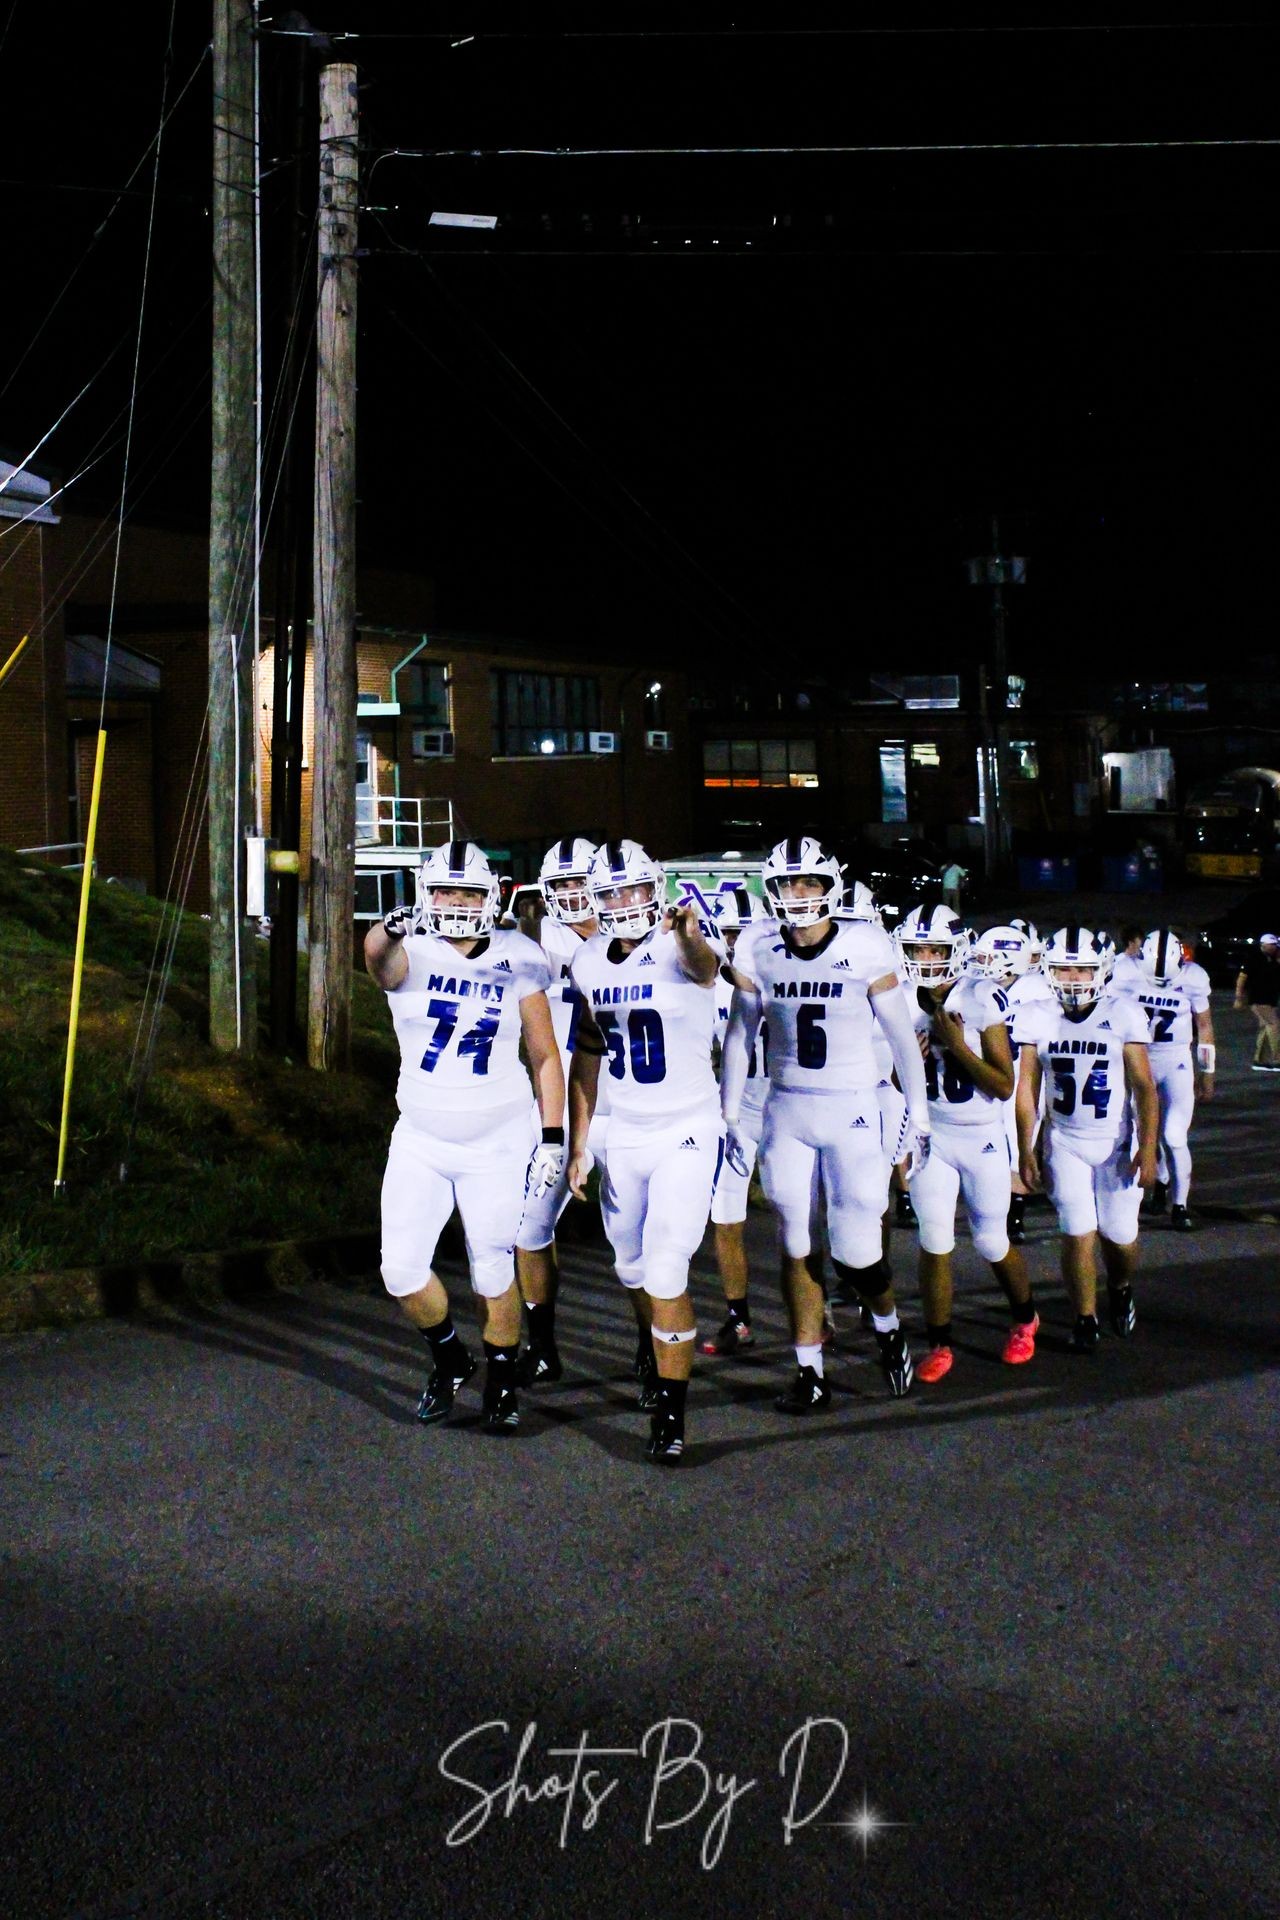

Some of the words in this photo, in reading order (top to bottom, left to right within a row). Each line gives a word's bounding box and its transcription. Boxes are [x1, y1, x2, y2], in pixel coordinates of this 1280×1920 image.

[427, 974, 504, 1002] MARION
[592, 984, 653, 1005] MARION
[773, 981, 843, 998] MARION
[1138, 995, 1180, 1007] MARION
[420, 999, 502, 1075] 74
[595, 1008, 667, 1084] 50
[796, 1003, 828, 1070] 6
[1047, 1040, 1107, 1056] MARION
[1050, 1057, 1112, 1119] 54
